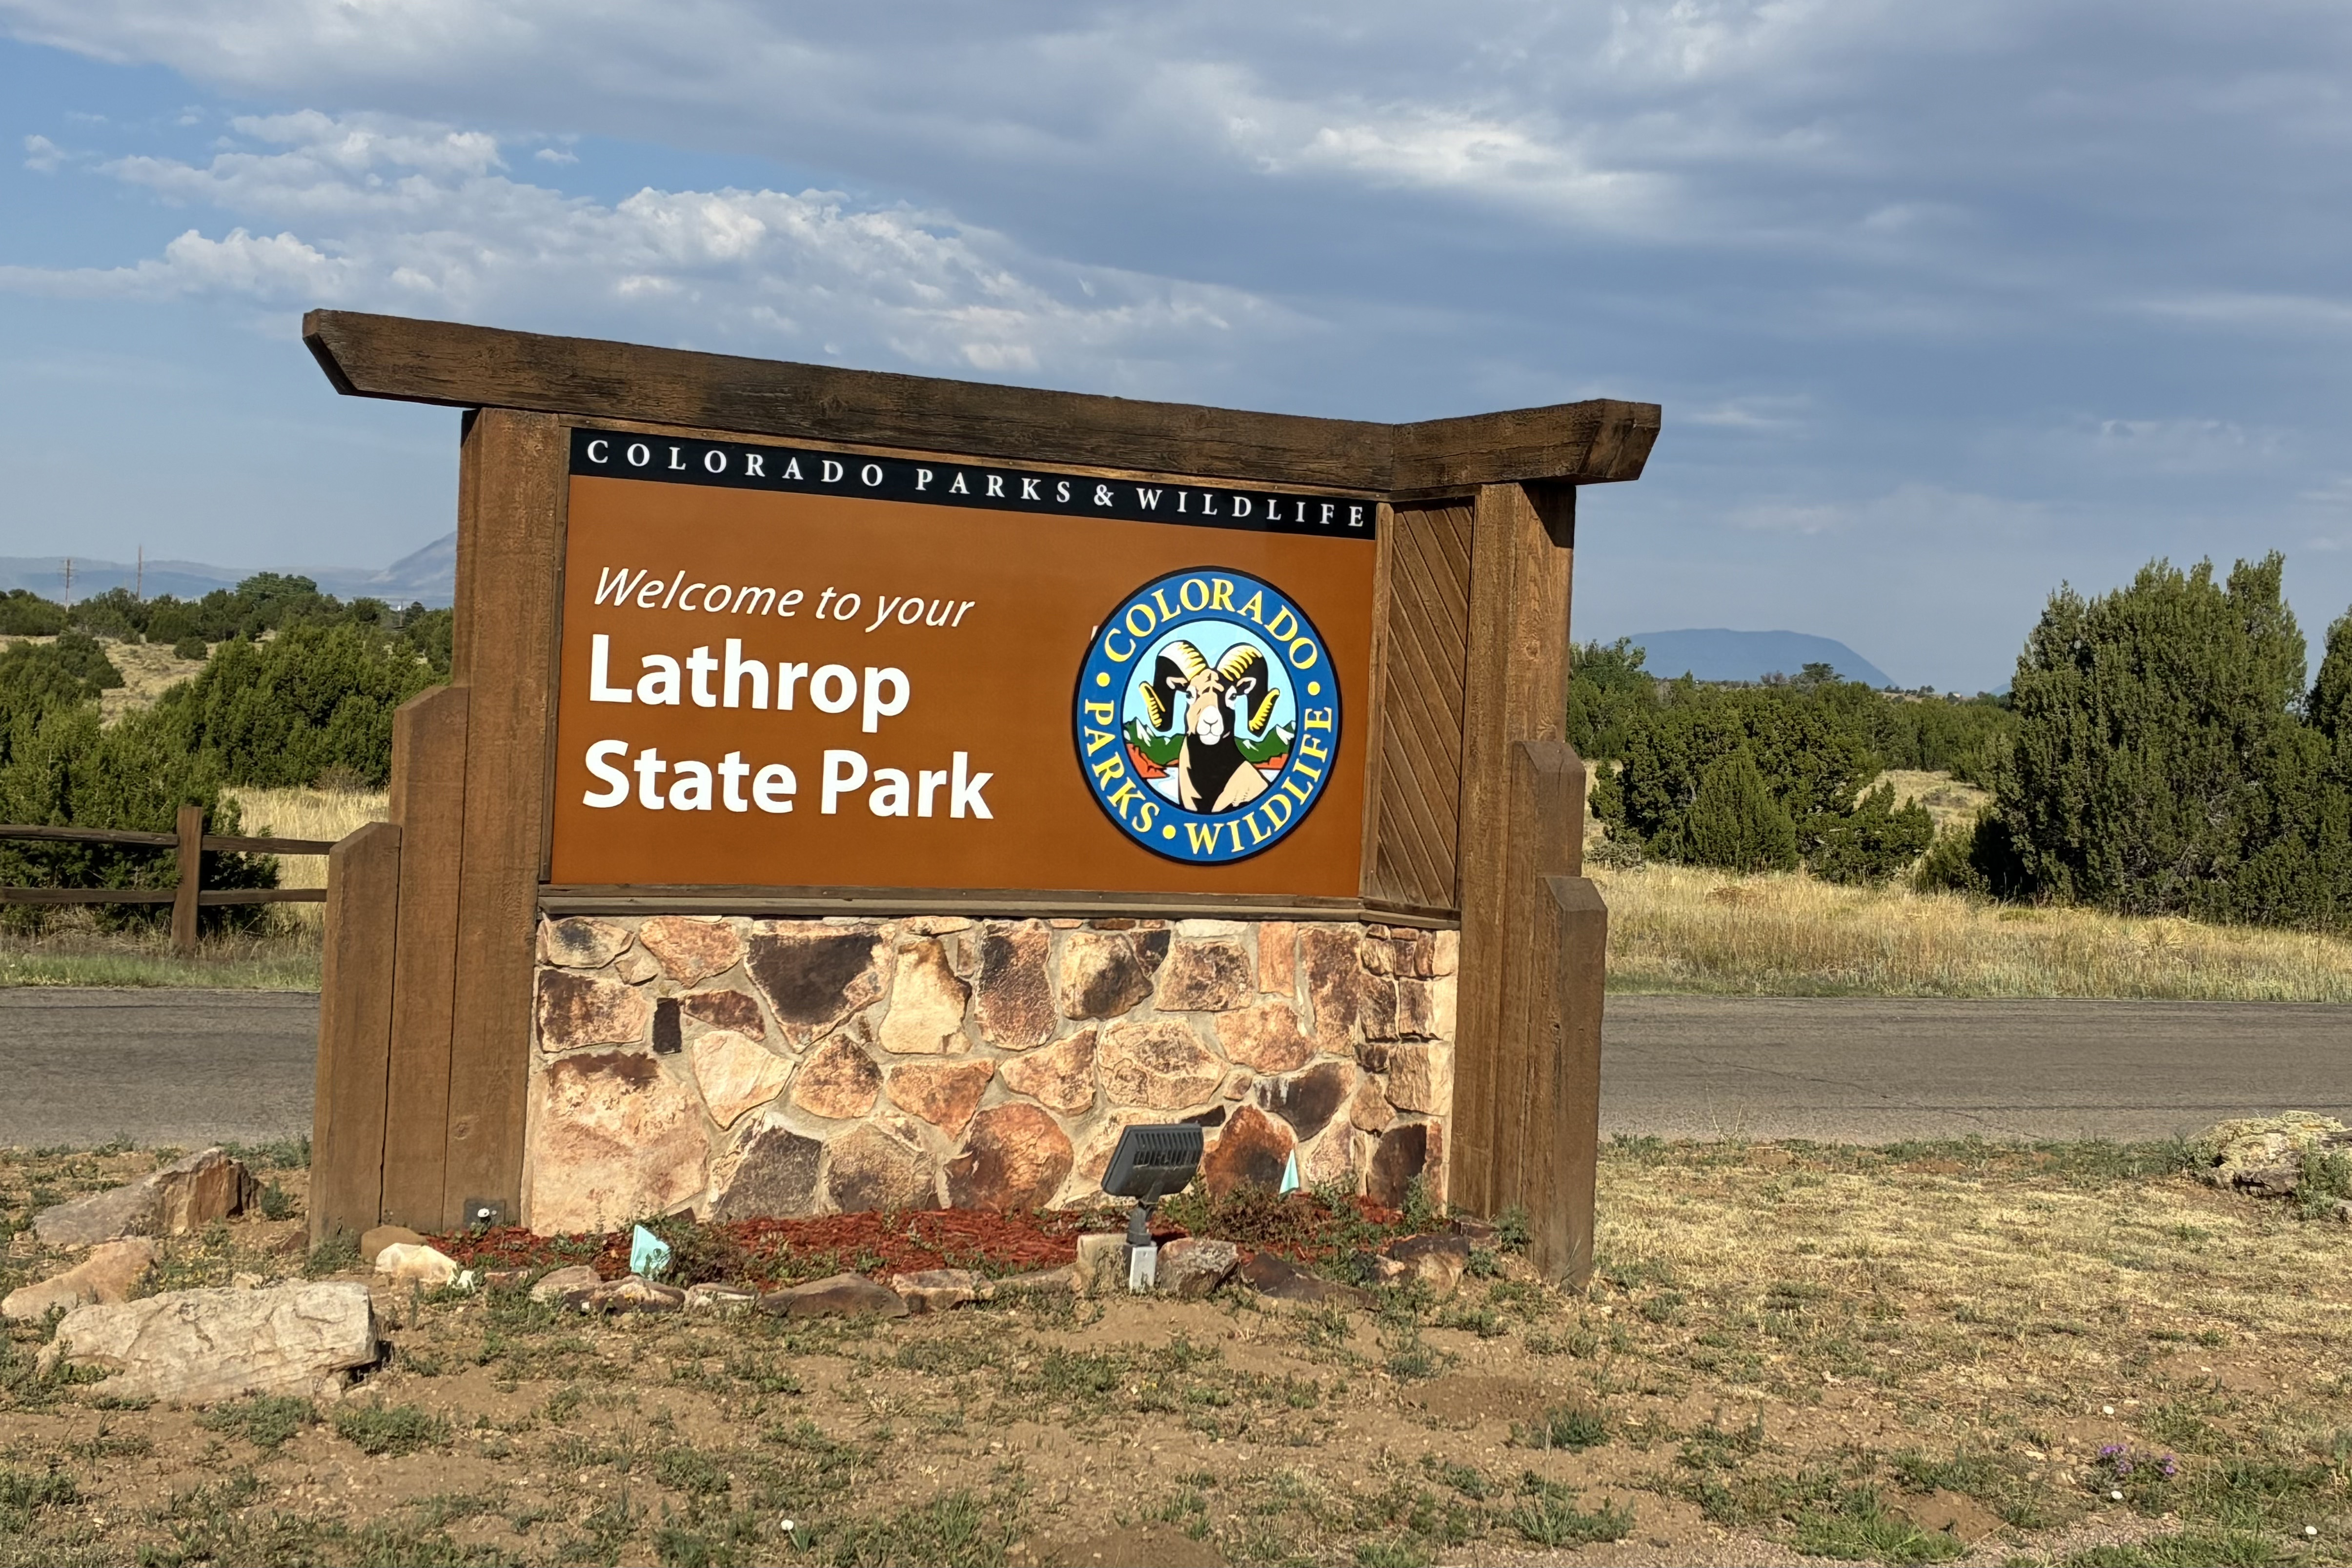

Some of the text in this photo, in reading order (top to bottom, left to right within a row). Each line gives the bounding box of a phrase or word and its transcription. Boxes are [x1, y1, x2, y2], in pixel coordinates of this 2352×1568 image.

[587, 439, 1364, 527] COLORADO PARKS & WILDLIFE
[594, 566, 976, 633] Welcome to your
[1104, 577, 1318, 670] COLORADO
[589, 633, 911, 733] Lathrop
[582, 739, 994, 820] State Park
[1083, 698, 1333, 855] PARKS WILDLIFE
